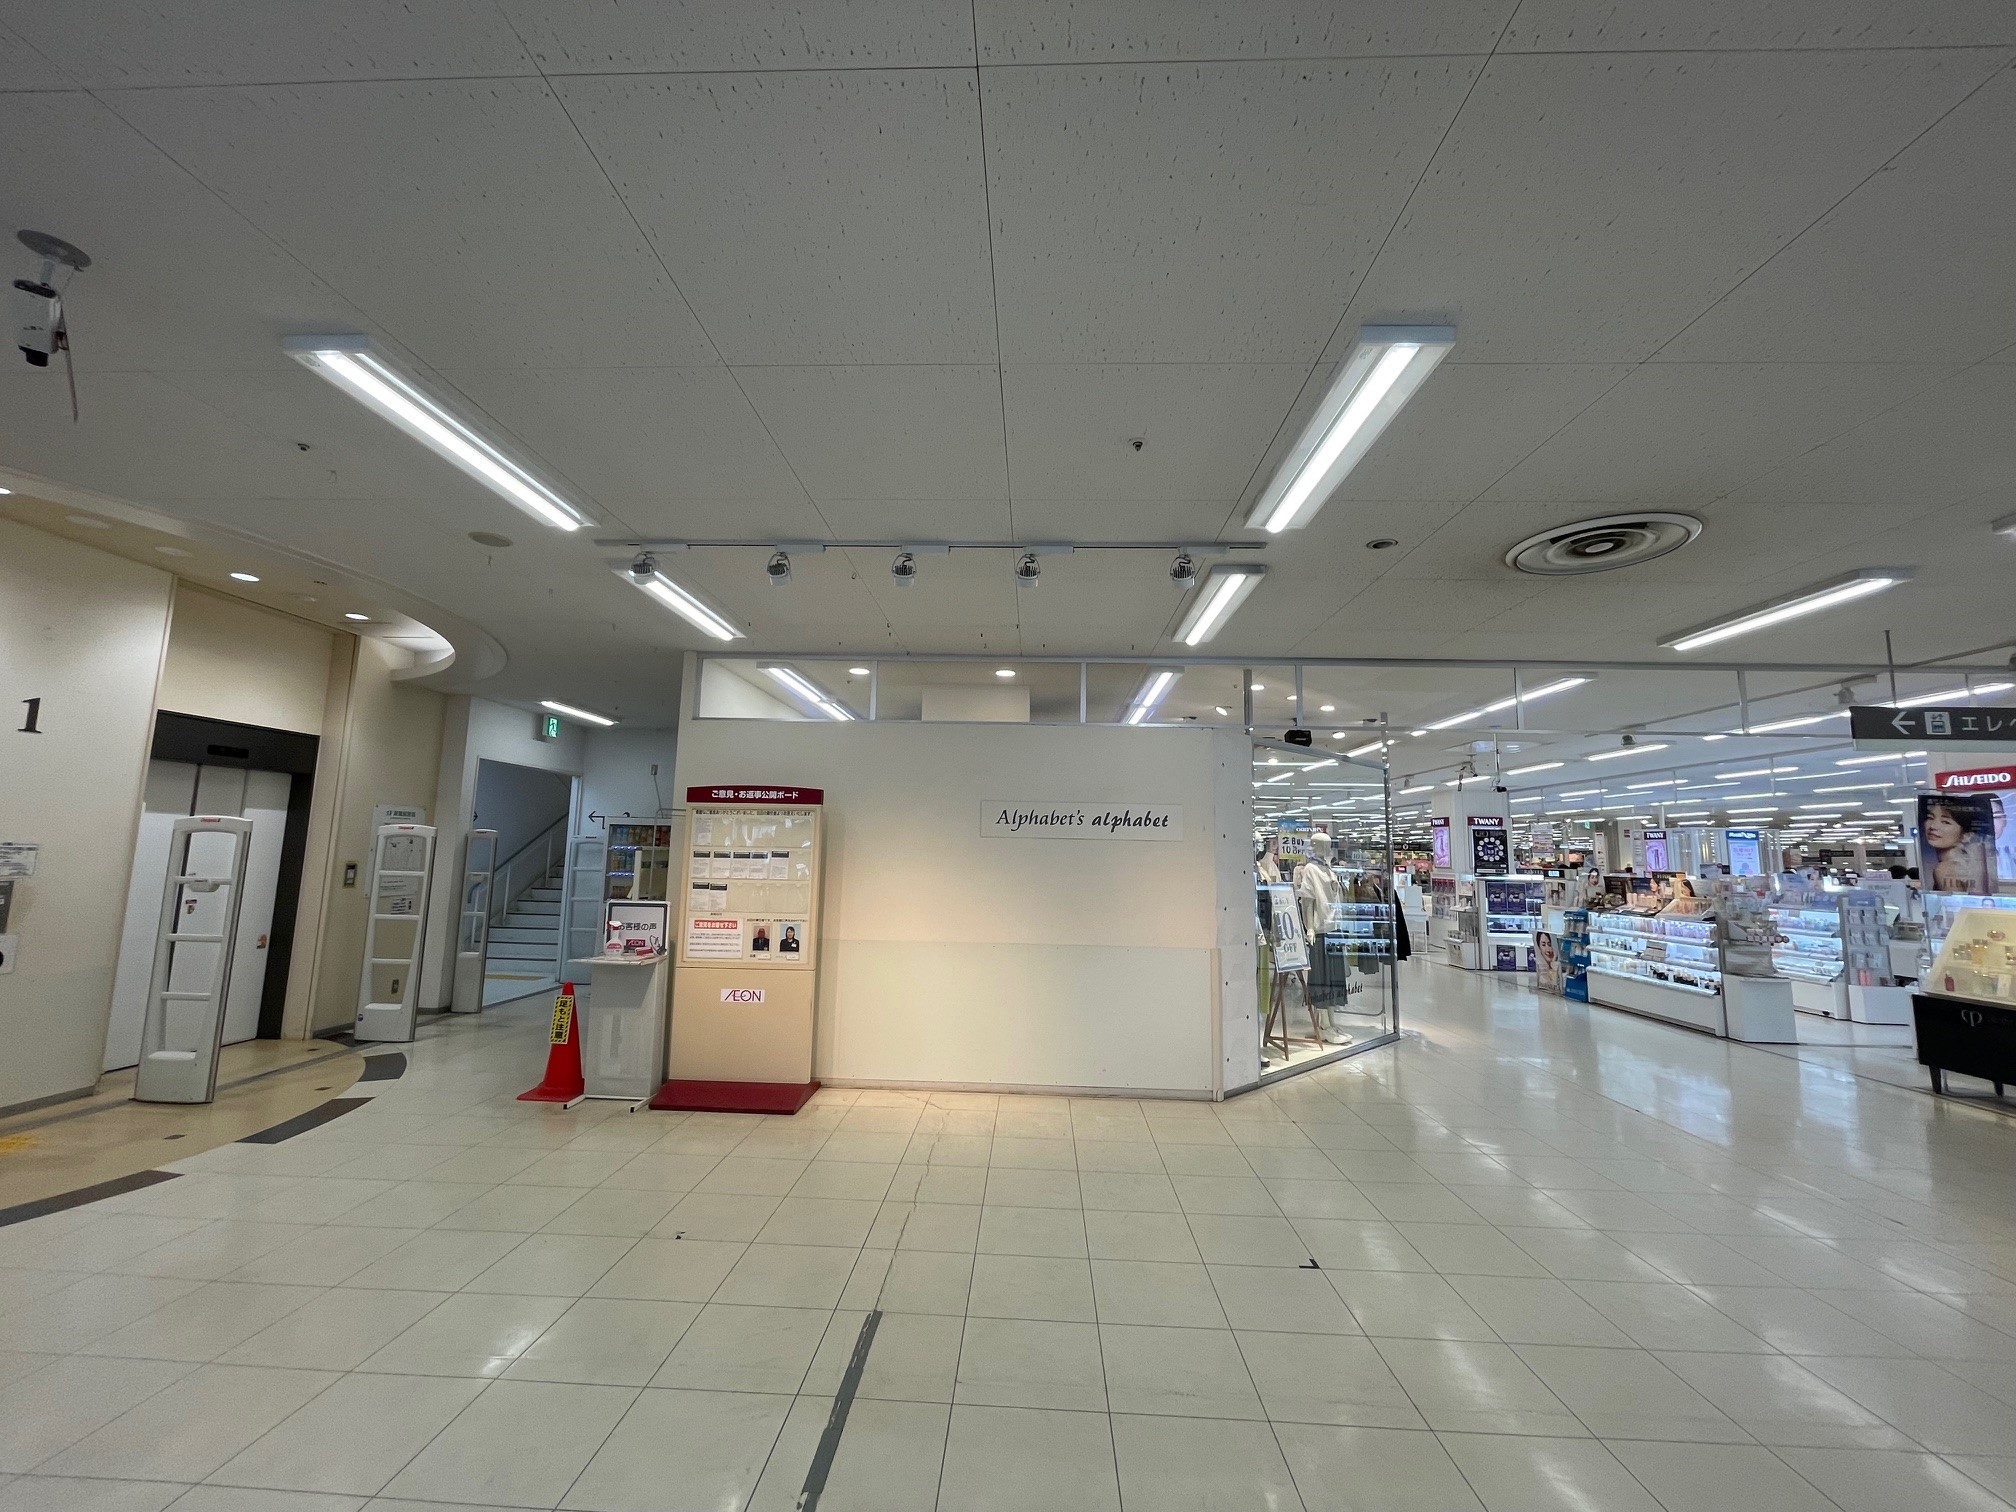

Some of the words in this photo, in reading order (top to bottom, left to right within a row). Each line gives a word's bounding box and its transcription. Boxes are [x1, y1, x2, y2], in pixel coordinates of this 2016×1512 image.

[18, 697, 42, 733] 1
[1942, 772, 2011, 788] SHISEIDO
[995, 809, 1085, 832] Alphabet's
[1091, 809, 1169, 833] alphabet
[1474, 817, 1500, 826] TWANY
[619, 922, 656, 931] お客様の声
